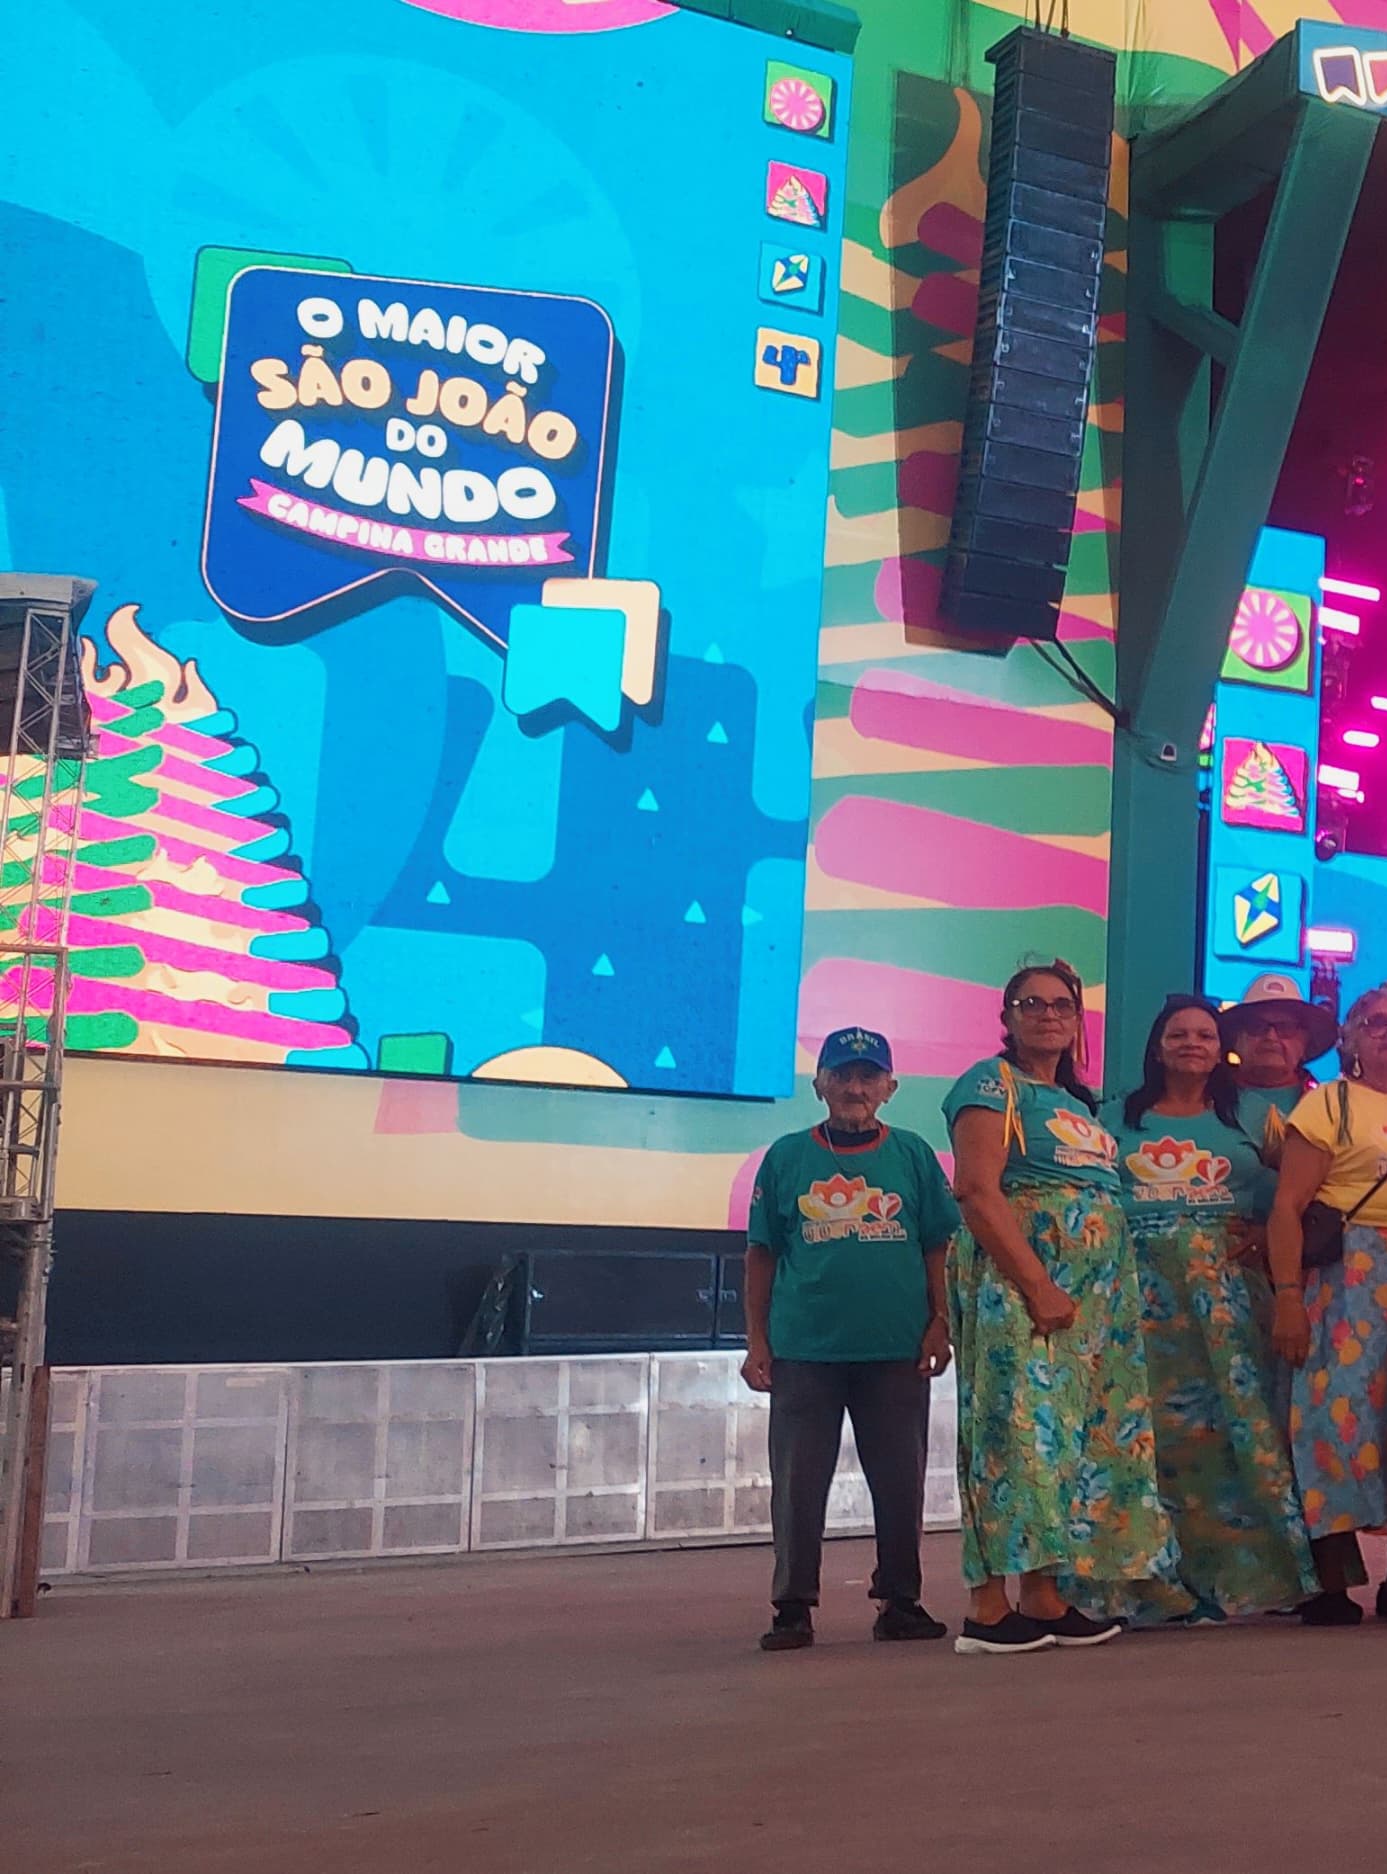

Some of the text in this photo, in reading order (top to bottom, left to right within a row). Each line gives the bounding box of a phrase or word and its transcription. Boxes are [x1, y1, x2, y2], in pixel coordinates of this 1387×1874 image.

[297, 297, 547, 384] O MAIOR
[250, 344, 577, 460] SÃO JOÃO
[385, 417, 448, 458] DO
[260, 419, 557, 523] MUNDO
[267, 494, 549, 564] CAMPINA GRANDE
[839, 1031, 880, 1048] BRASIL
